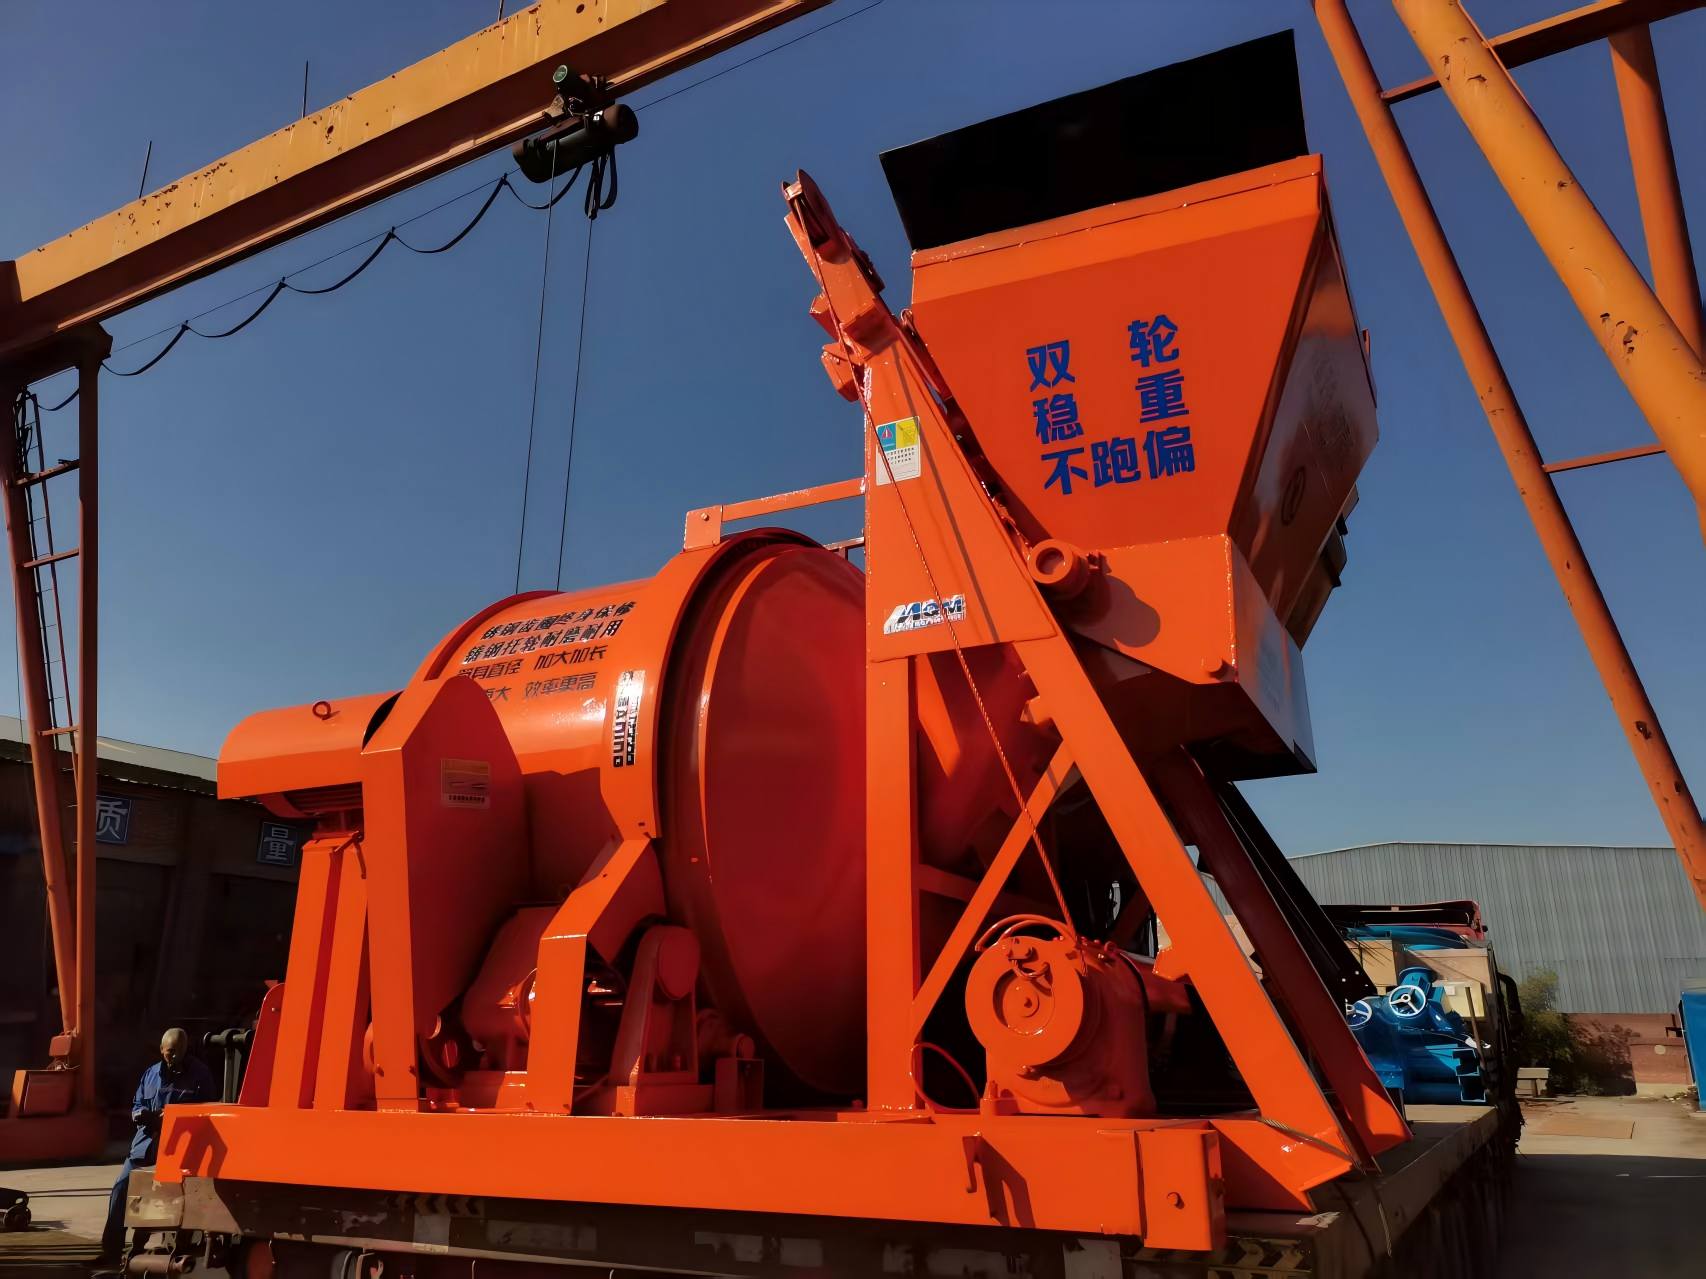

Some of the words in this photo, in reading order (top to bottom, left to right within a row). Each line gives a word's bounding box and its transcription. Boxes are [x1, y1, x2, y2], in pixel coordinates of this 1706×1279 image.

[1026, 340, 1075, 392] 双
[1128, 314, 1179, 367] 轮
[1032, 393, 1084, 444] 稳
[1135, 368, 1190, 424] 重
[1040, 426, 1195, 495] 不跑偏
[533, 645, 609, 671] 加大加长
[525, 672, 599, 698] 效率更高
[96, 800, 128, 840] 质
[263, 827, 296, 861] 量
